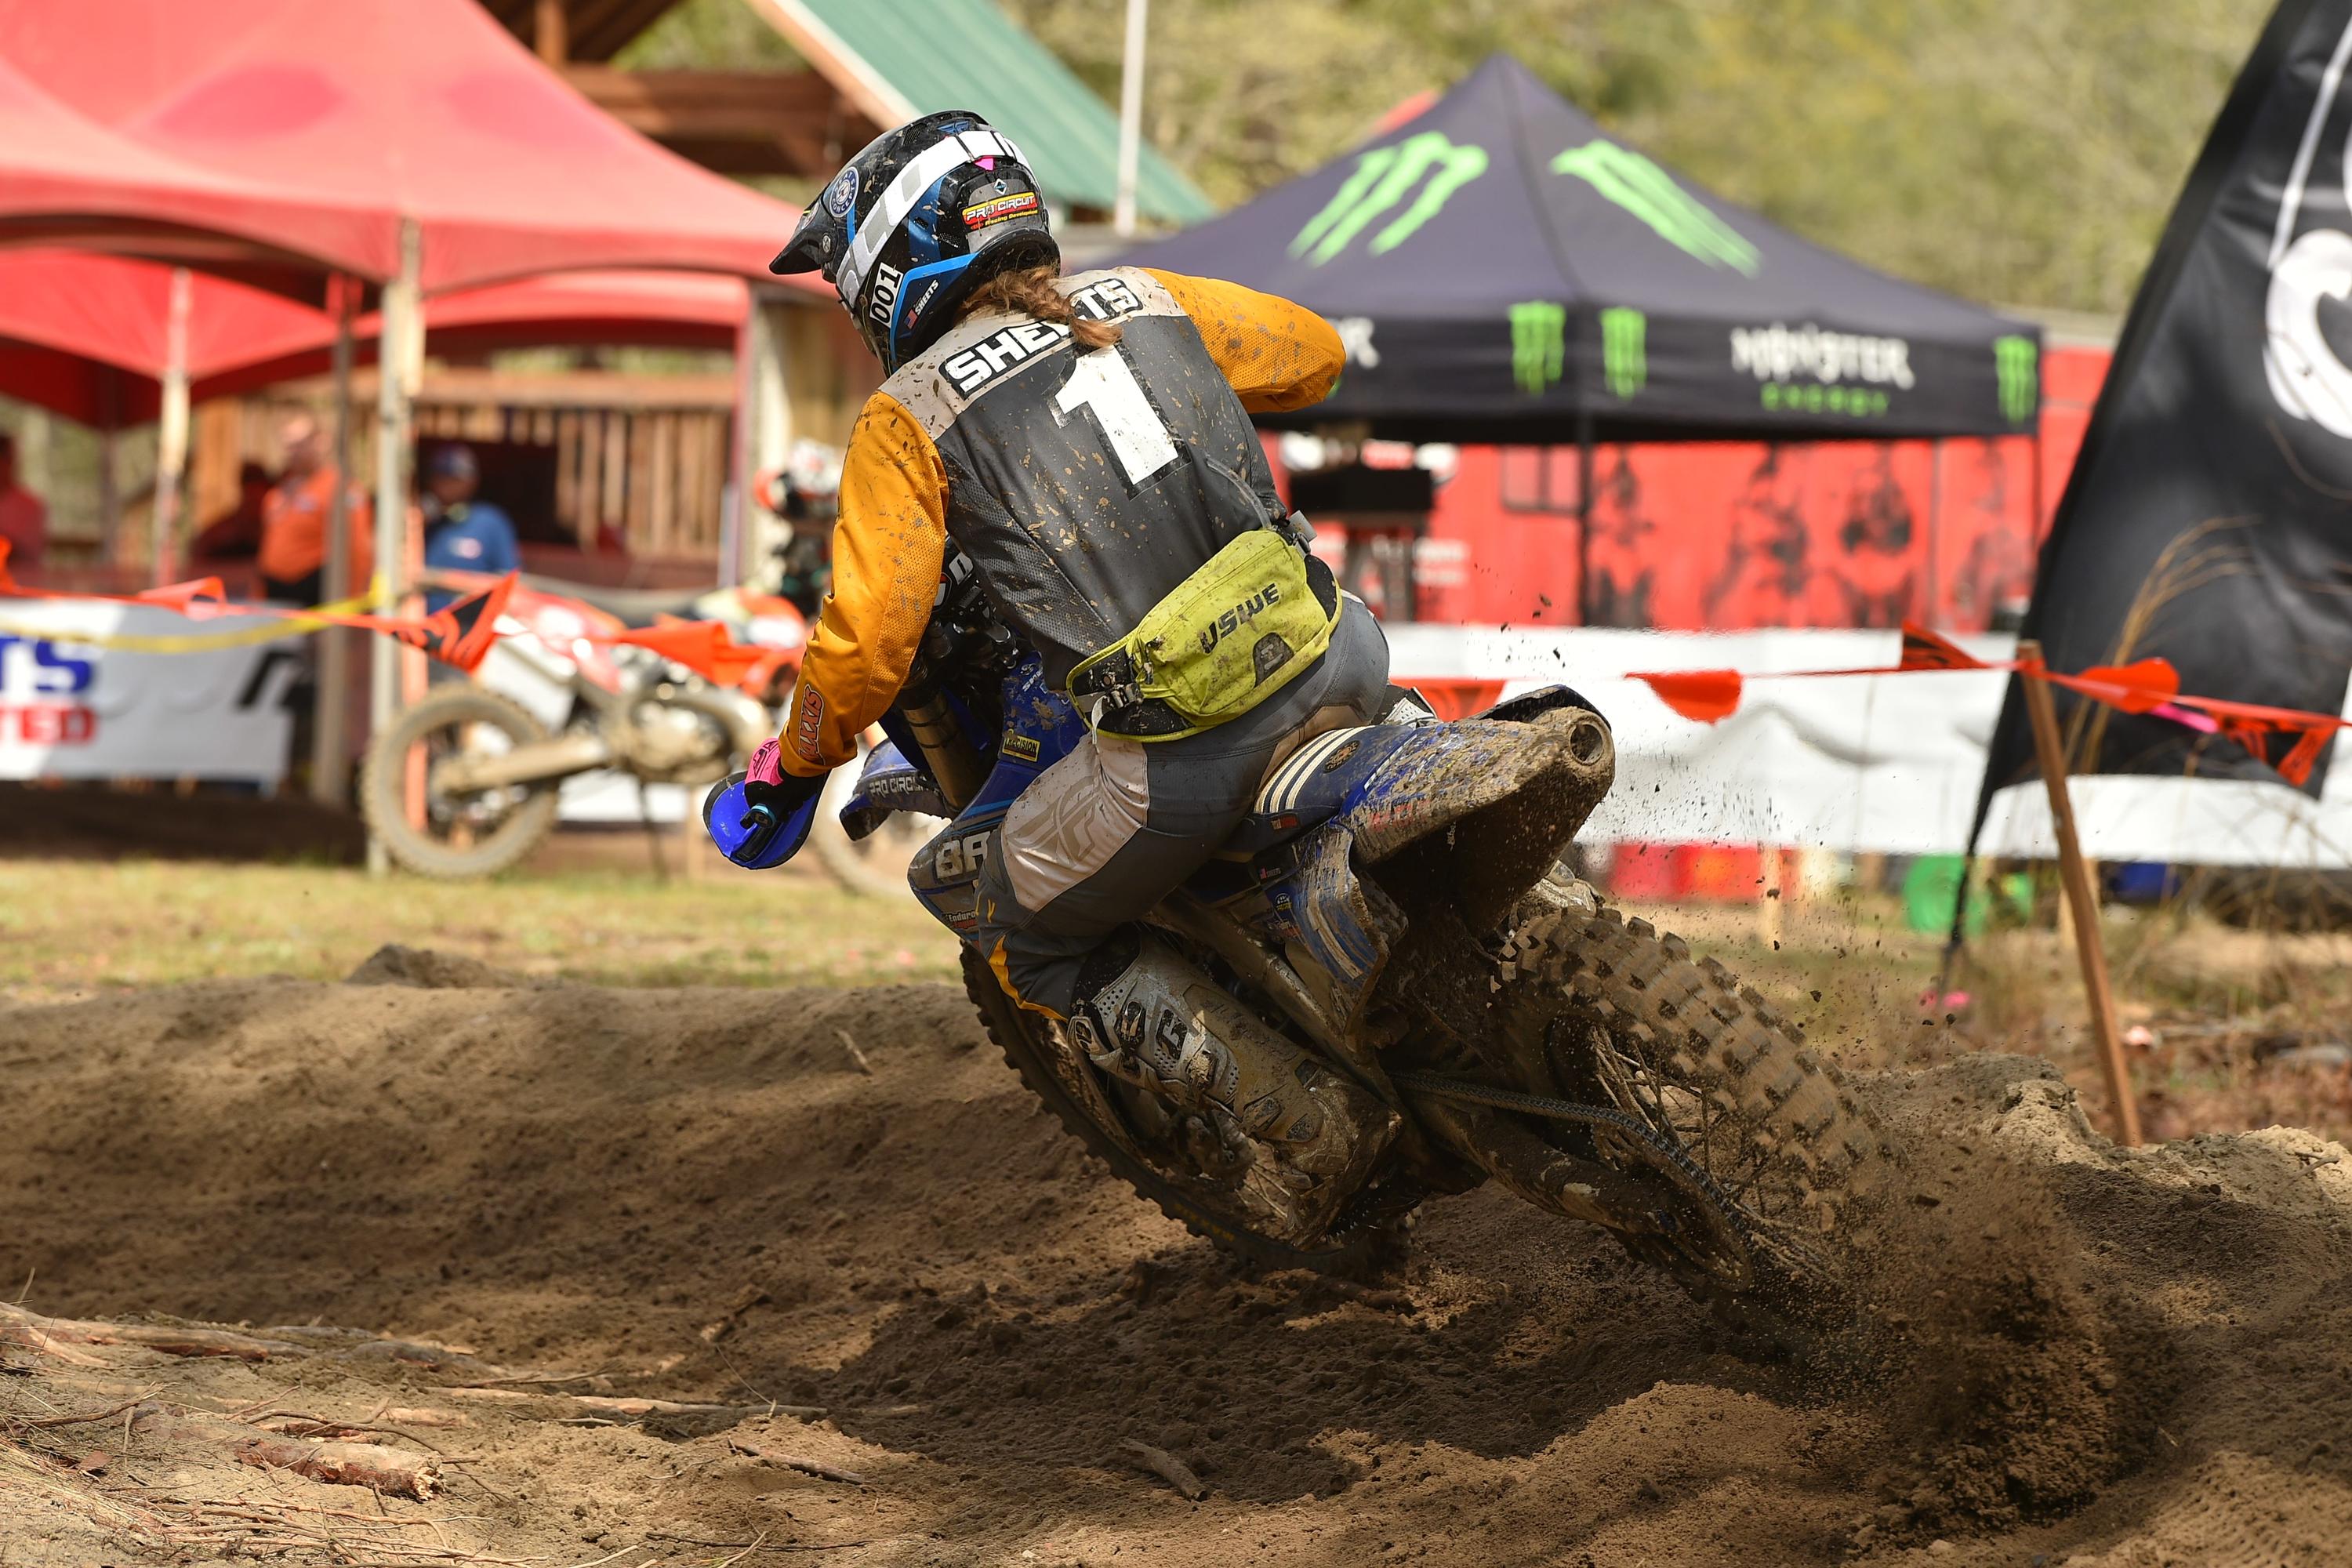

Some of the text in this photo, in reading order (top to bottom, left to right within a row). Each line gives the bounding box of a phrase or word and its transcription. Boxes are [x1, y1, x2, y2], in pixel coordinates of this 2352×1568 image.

[967, 195, 1035, 221] PRO CIRCUIT
[985, 216, 1008, 227] Racing
[871, 269, 902, 324] 001
[915, 279, 939, 315] SHEETS
[1054, 345, 1178, 485] 1
[1199, 583, 1279, 654] USWE
[869, 779, 889, 798] PRO
[949, 911, 976, 923] Enduro
